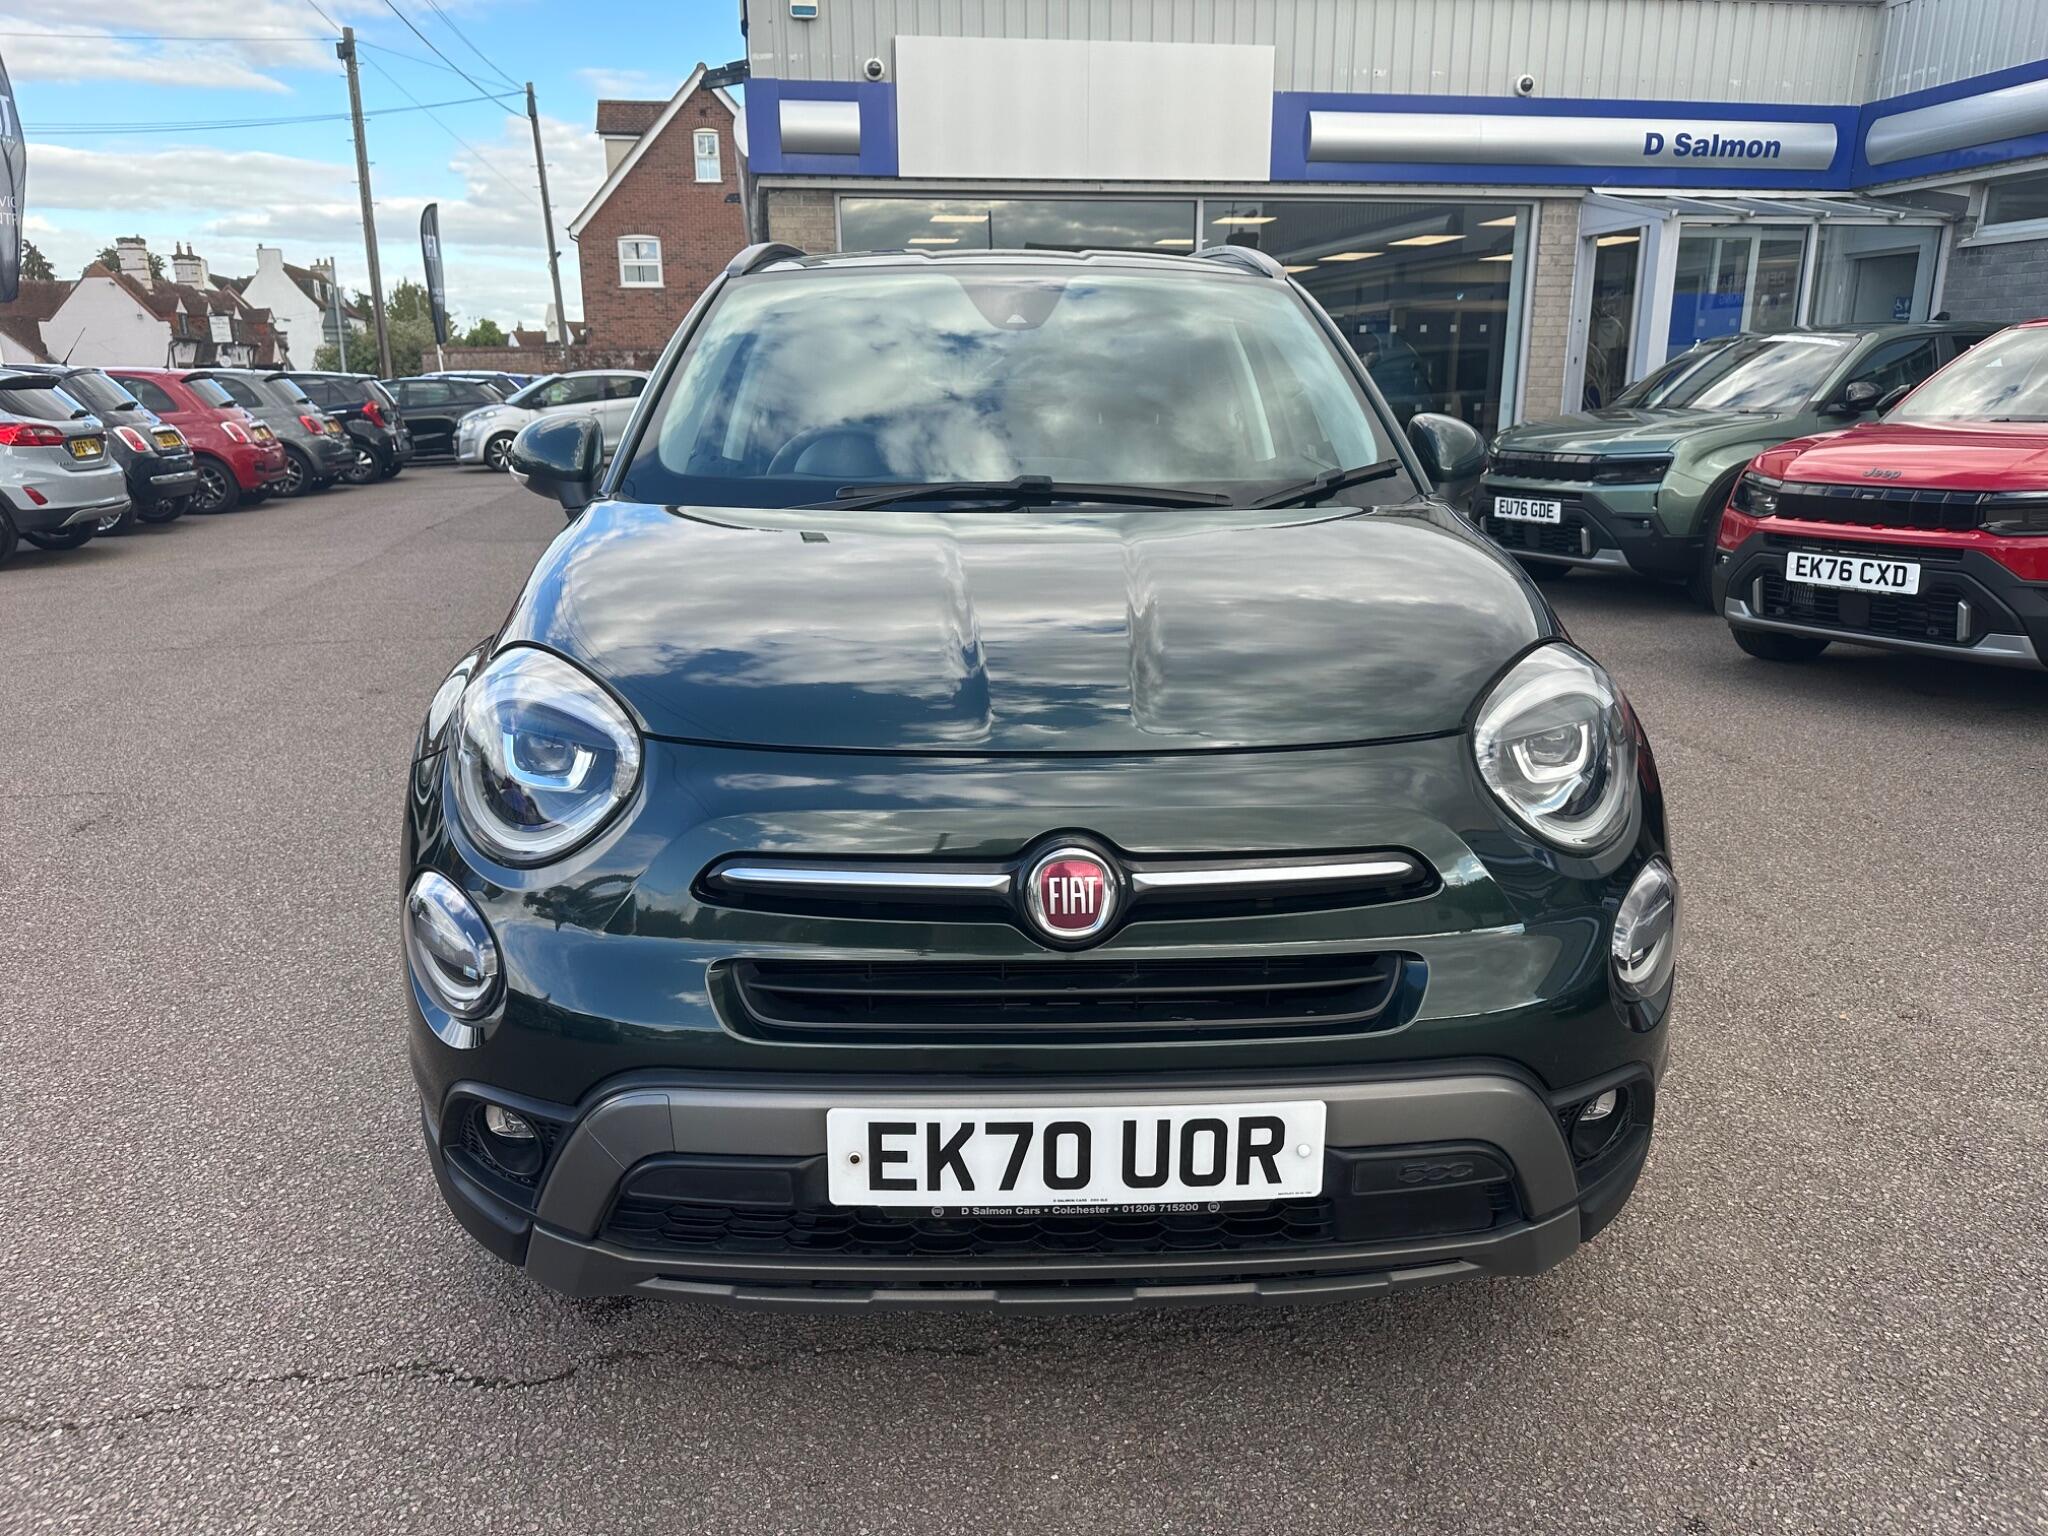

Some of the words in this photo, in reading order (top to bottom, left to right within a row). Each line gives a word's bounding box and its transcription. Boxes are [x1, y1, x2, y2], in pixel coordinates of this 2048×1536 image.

[1643, 132, 1665, 156] D
[1673, 132, 1781, 158] Salmon
[1862, 467, 1902, 480] Jeep
[1499, 499, 1528, 516] EU76
[1530, 502, 1555, 519] GDE
[1795, 555, 1853, 582] EK76
[1859, 561, 1908, 587] CXD
[1048, 876, 1098, 915] FIAT
[868, 1120, 1092, 1192] EK70
[1121, 1115, 1286, 1189] UOR
[961, 1207, 970, 1215] D
[972, 1207, 1012, 1215] Salmon
[1015, 1207, 1040, 1215] Cars
[1052, 1205, 1110, 1214] Colchester
[1122, 1204, 1156, 1213] 01206
[1159, 1203, 1199, 1213] 715200
